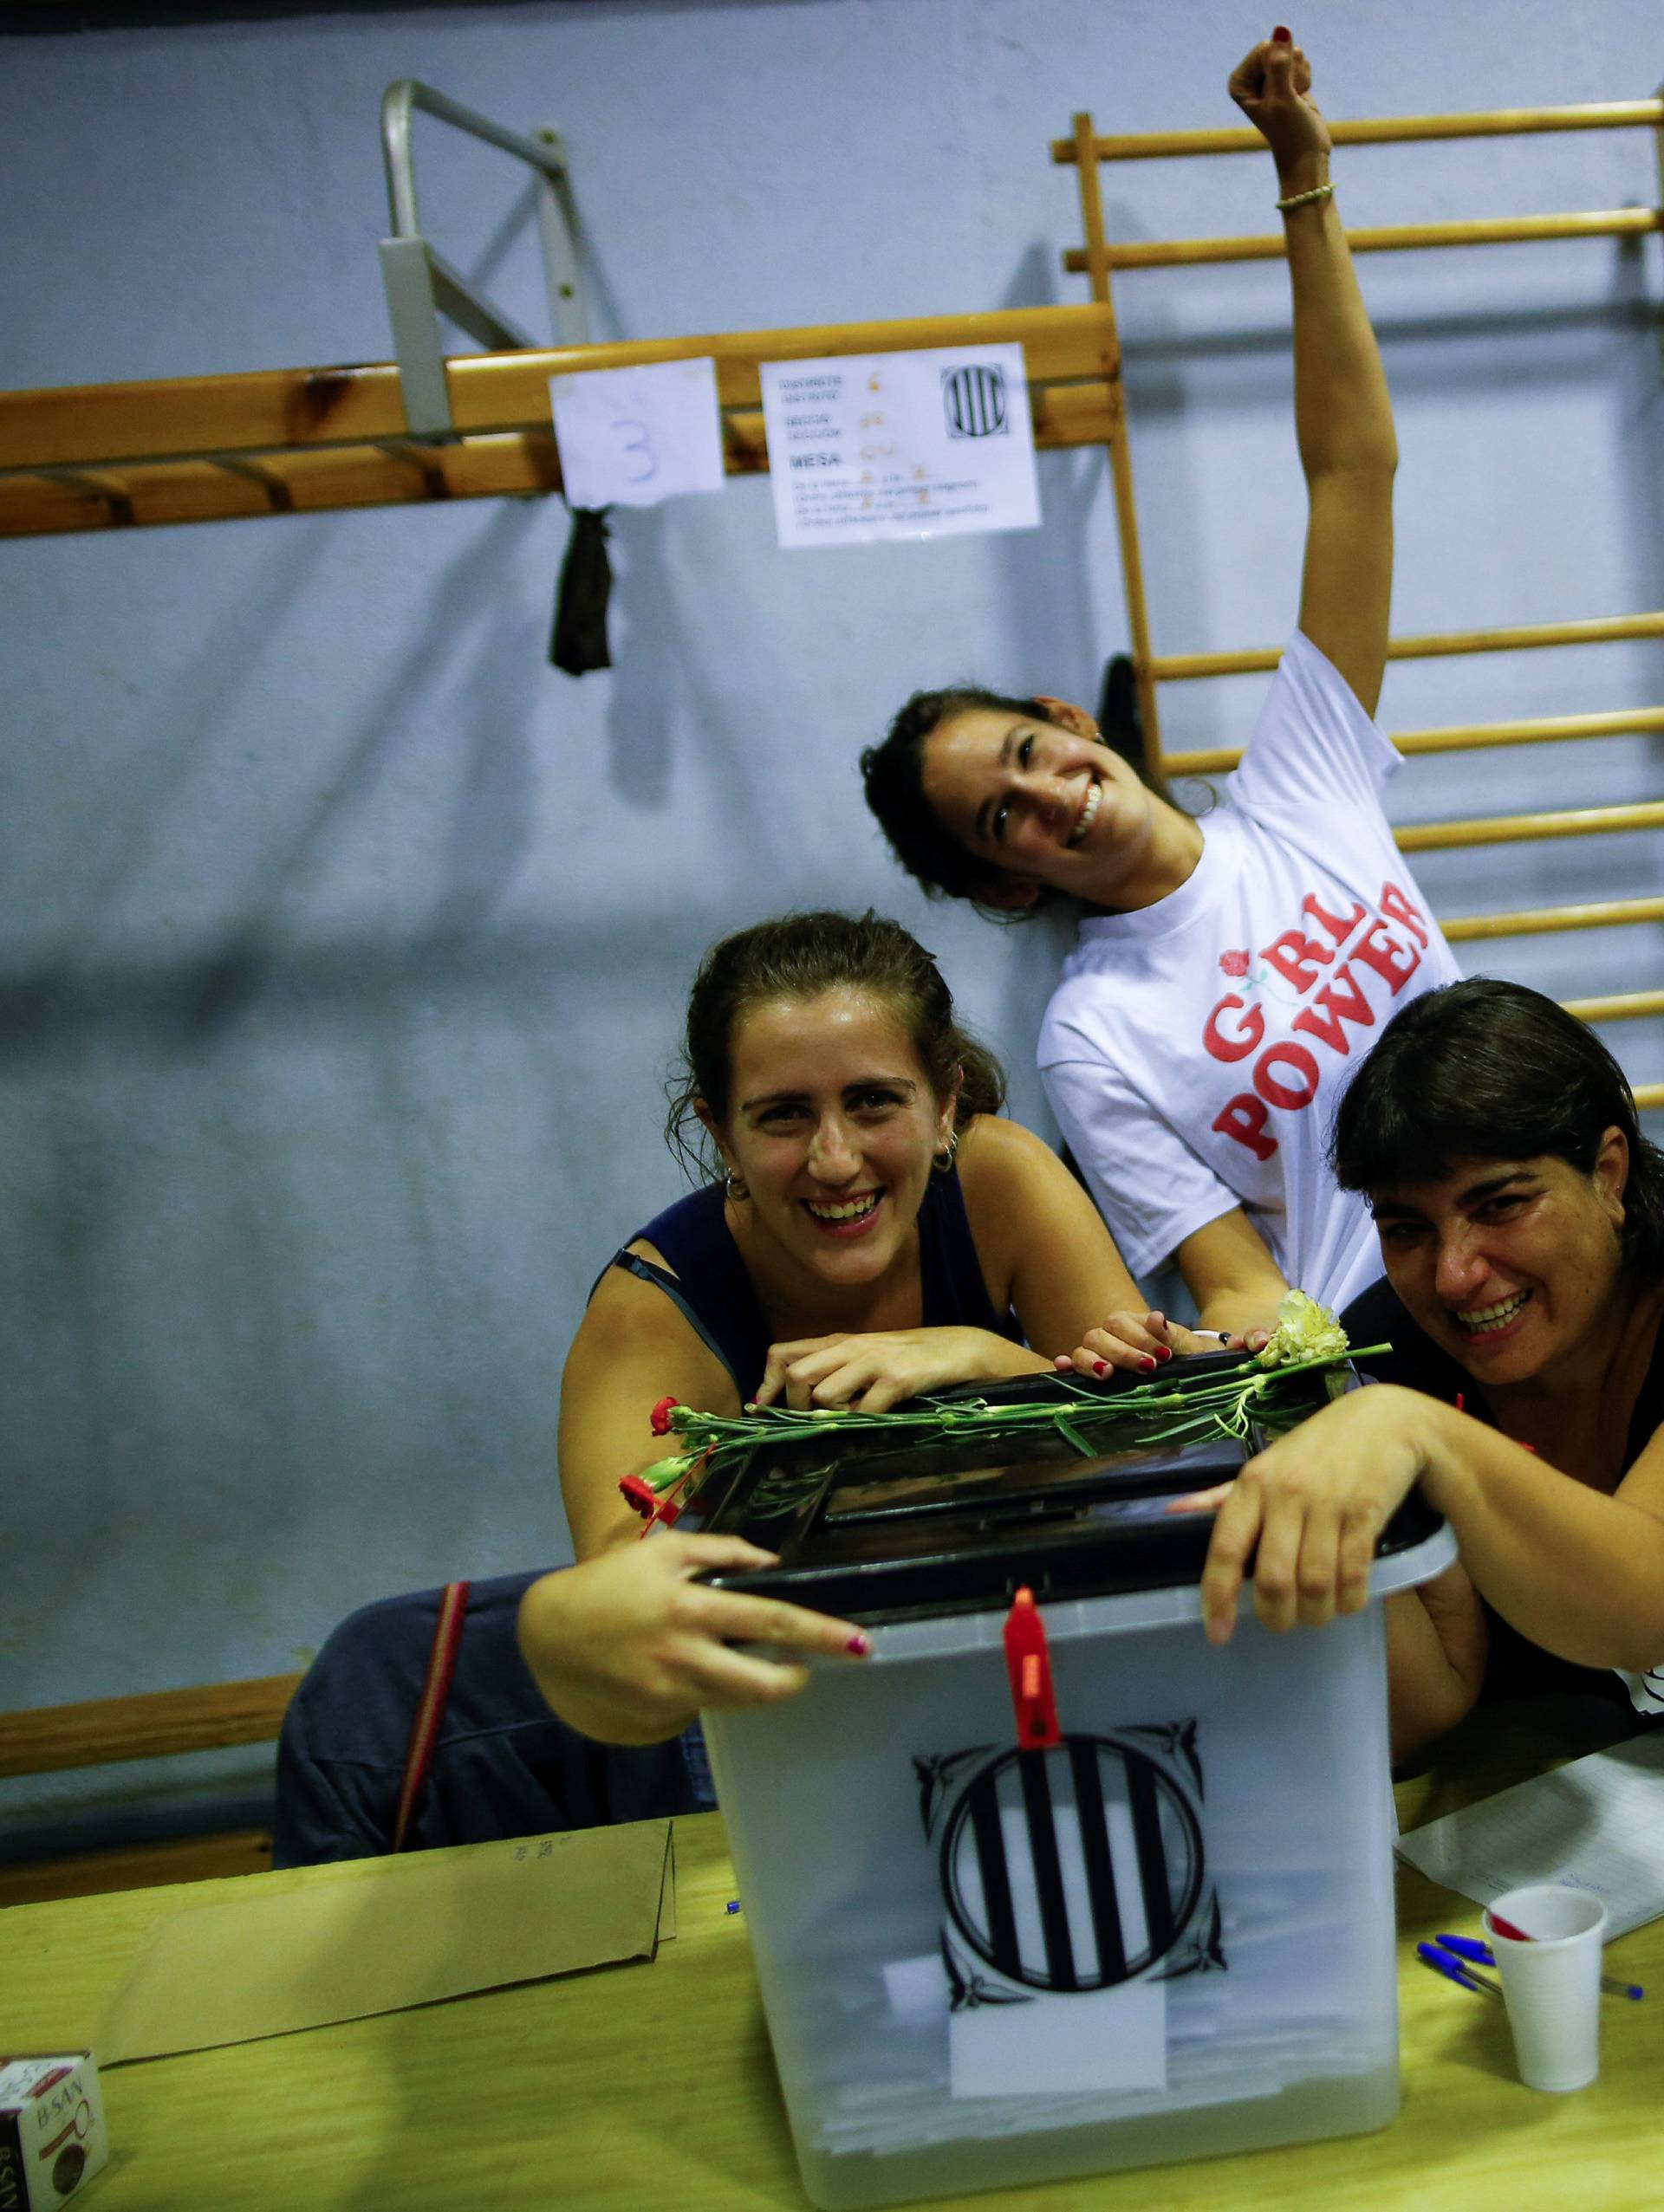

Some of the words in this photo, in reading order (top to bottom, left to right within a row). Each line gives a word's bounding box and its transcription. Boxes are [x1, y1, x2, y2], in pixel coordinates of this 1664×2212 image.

[609, 418, 659, 485] 3
[790, 452, 842, 470] MESA
[1212, 881, 1428, 1161] POWER
